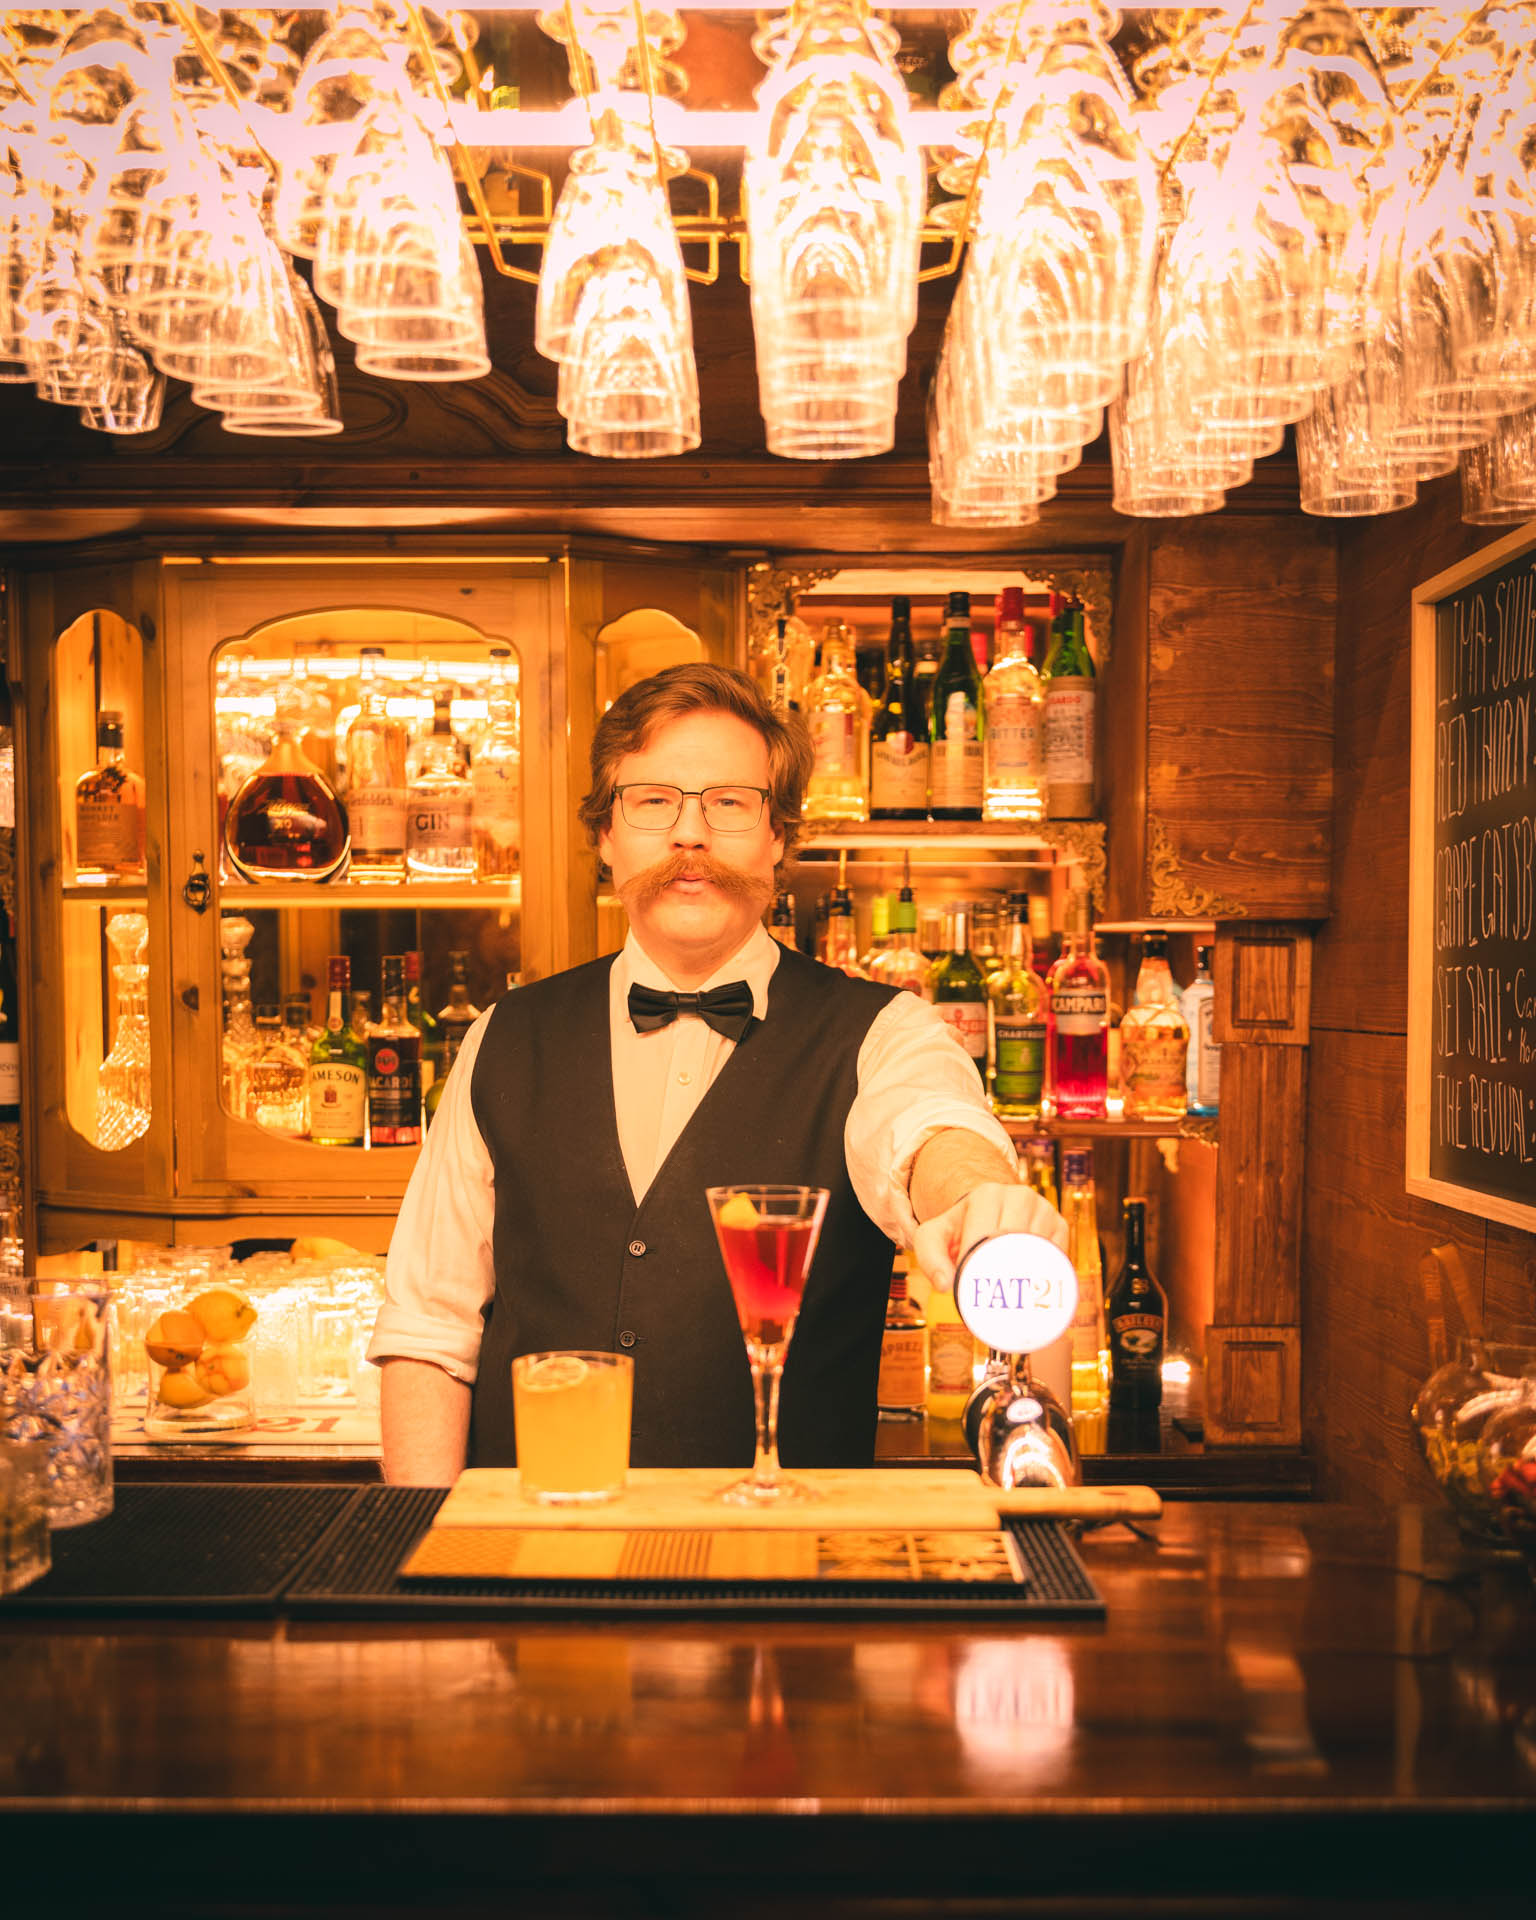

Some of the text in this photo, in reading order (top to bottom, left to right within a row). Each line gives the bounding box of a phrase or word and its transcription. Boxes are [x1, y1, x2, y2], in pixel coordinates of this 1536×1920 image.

[415, 813, 451, 831] GIN
[1480, 815, 1536, 941] GATSB
[312, 1069, 360, 1085] AMESON
